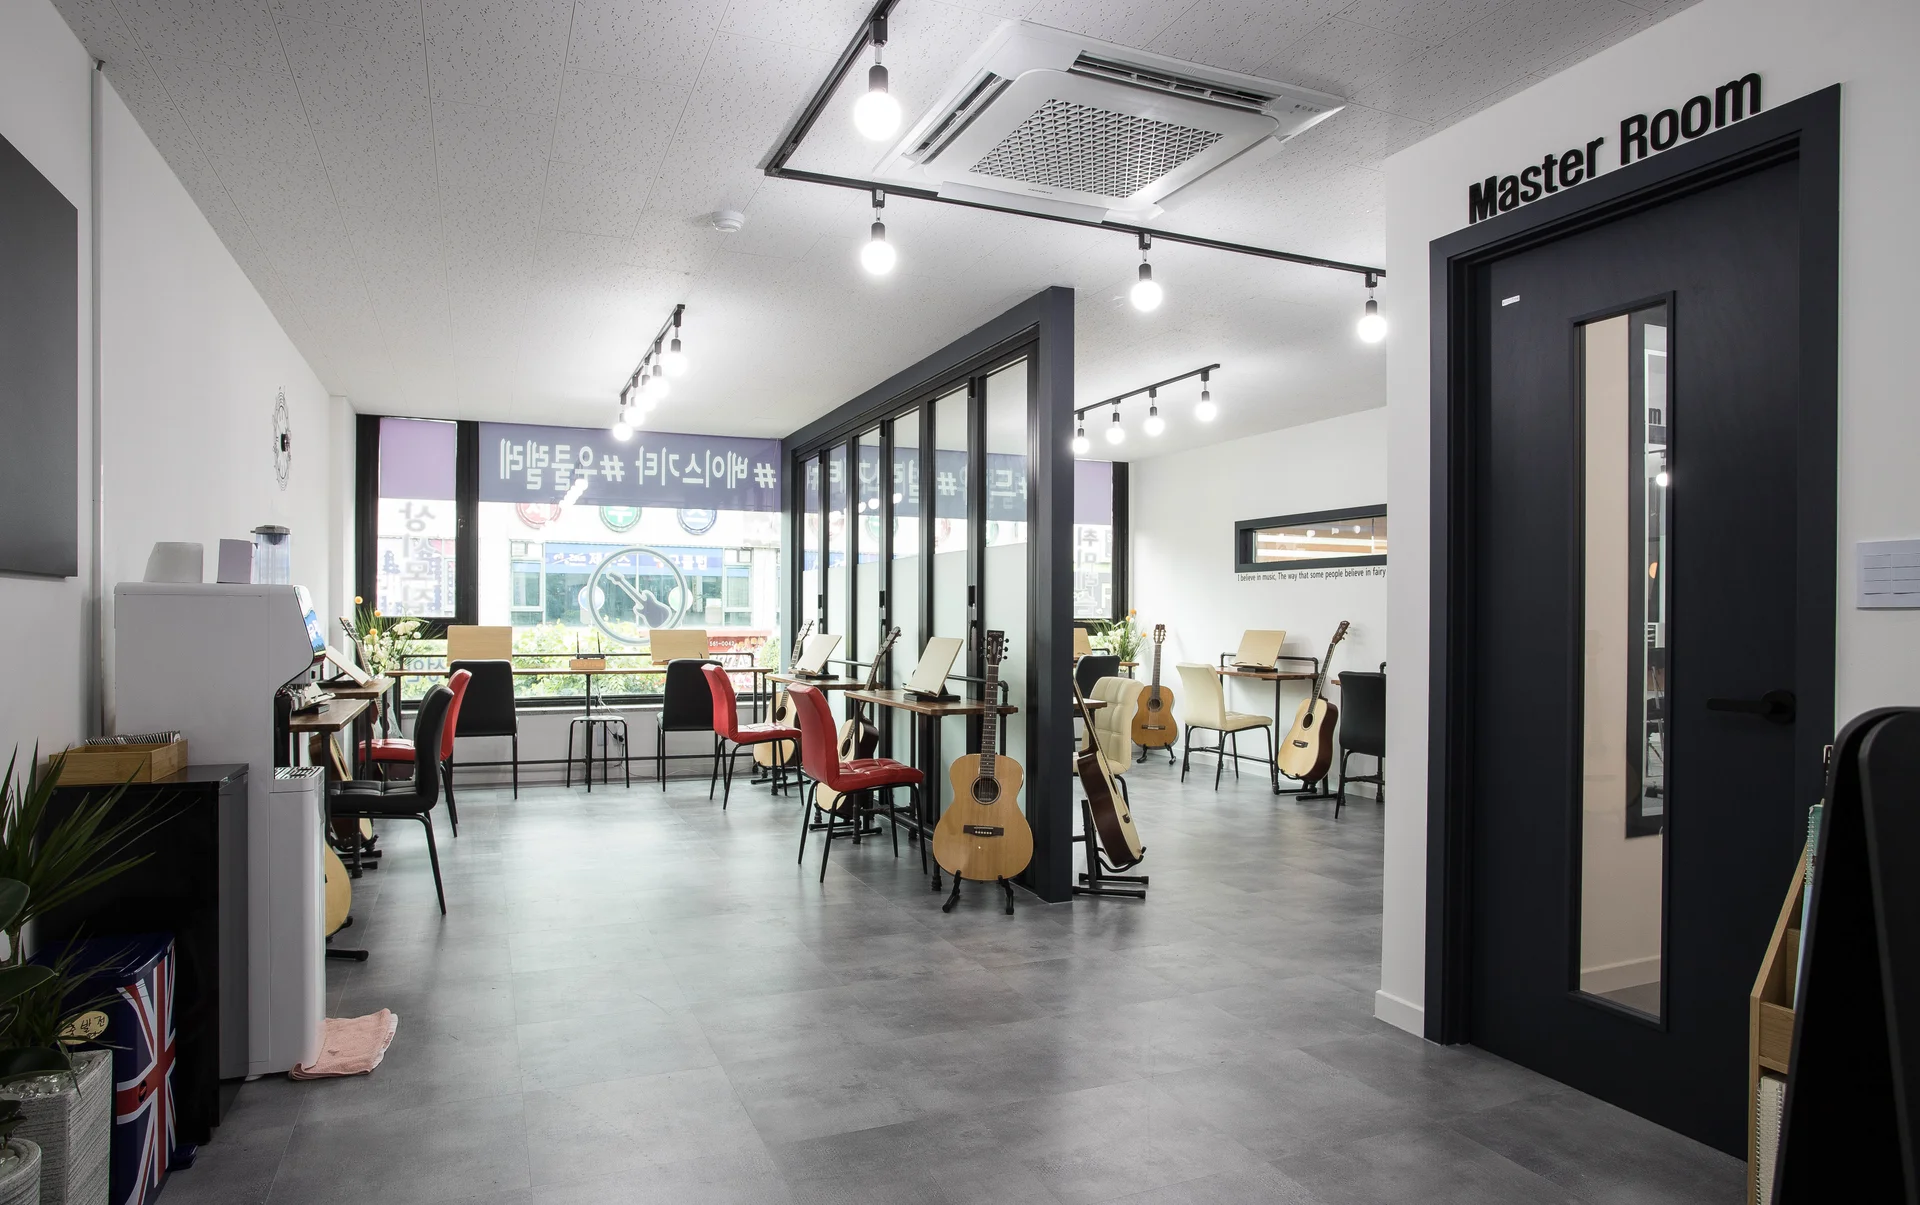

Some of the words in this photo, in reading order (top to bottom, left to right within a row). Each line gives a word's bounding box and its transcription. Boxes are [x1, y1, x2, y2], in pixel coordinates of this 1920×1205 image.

[1469, 136, 1604, 225] Master
[1620, 72, 1762, 166] Room
[1241, 573, 1256, 582] believe
[1278, 571, 1287, 580] The
[1288, 573, 1298, 581] way
[1299, 571, 1309, 580] that
[1310, 571, 1324, 579] some
[1325, 568, 1343, 580] people
[1345, 568, 1364, 577] believe
[1365, 567, 1372, 577] in
[1373, 566, 1387, 578] fairy
